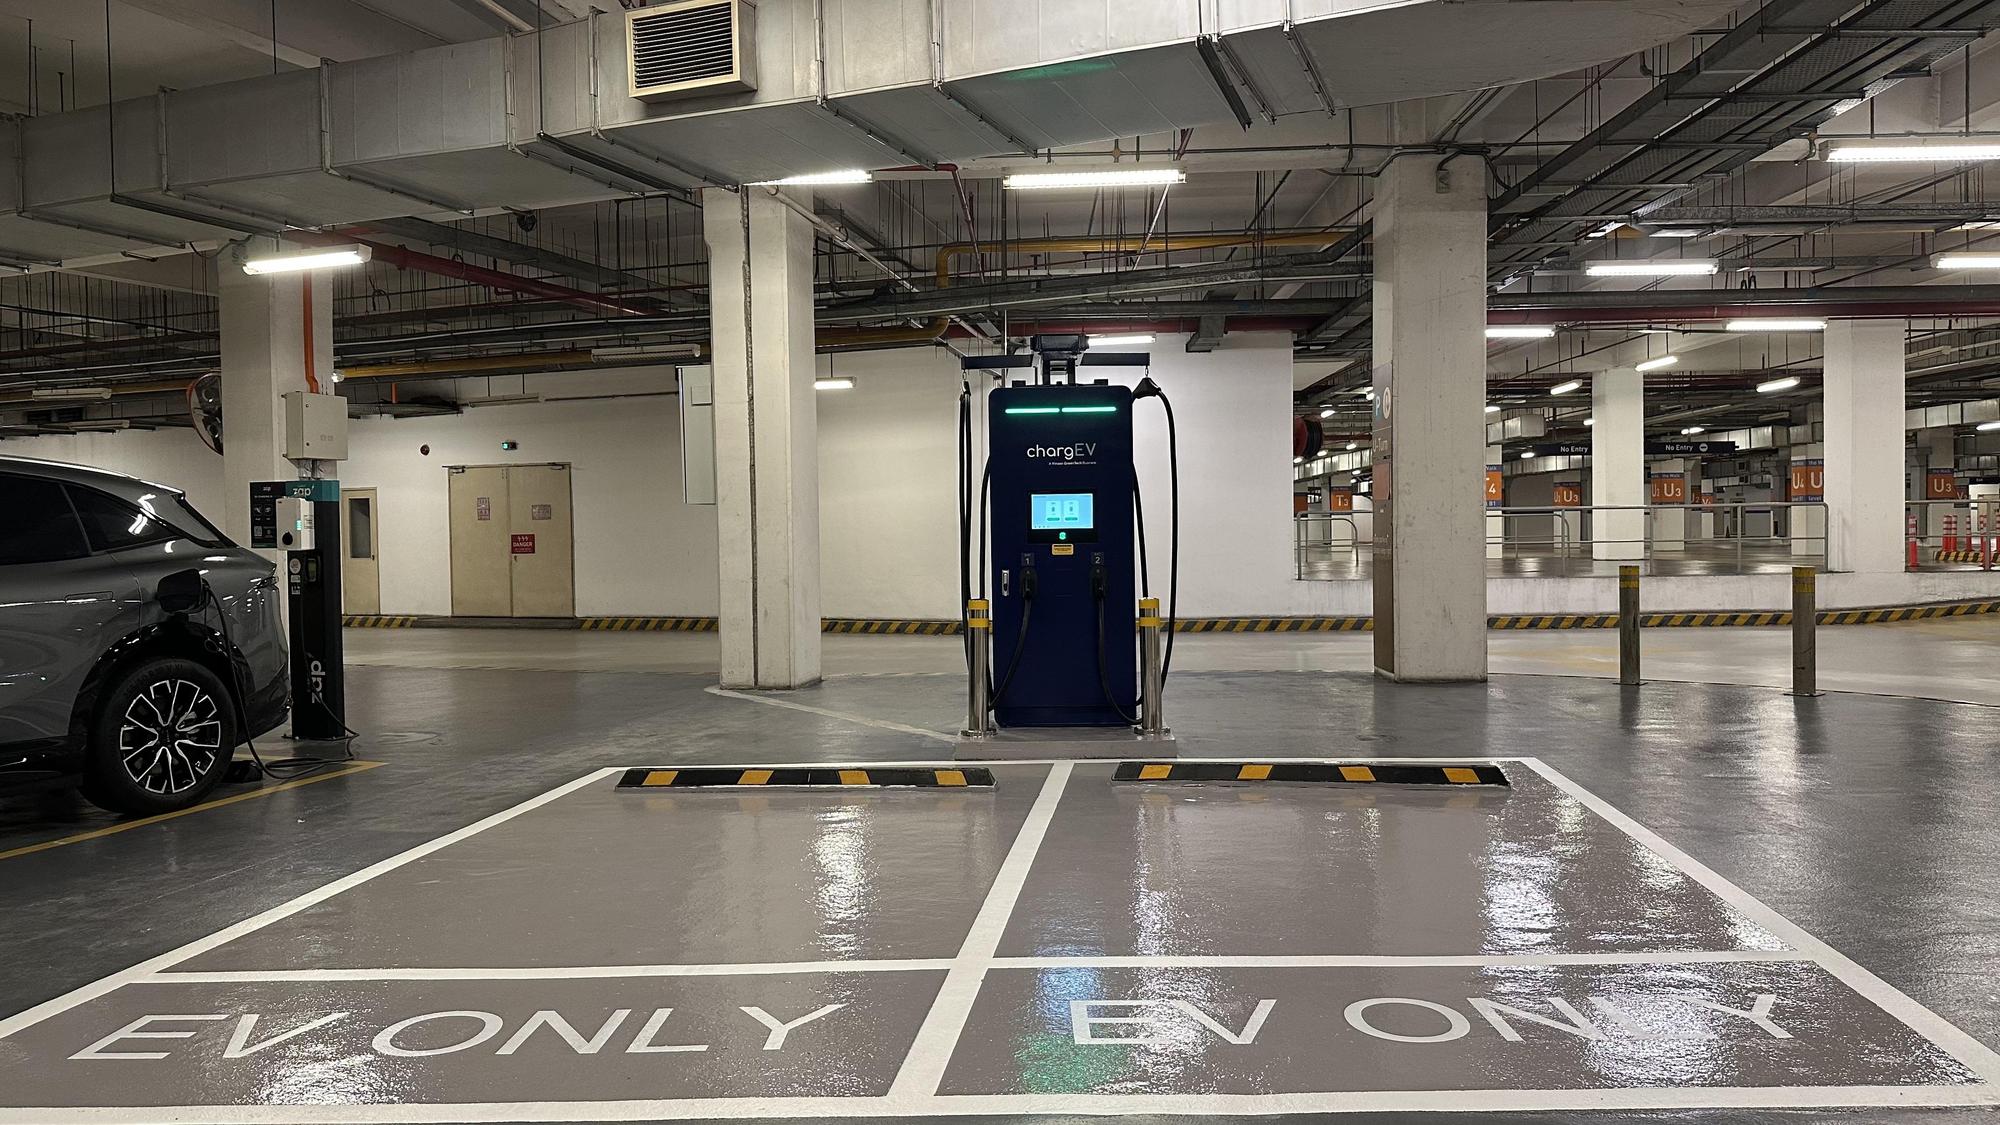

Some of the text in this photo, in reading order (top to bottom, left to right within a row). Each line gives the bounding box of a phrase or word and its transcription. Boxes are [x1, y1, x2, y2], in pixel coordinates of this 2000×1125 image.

[1026, 443, 1096, 460] chargEV
[1810, 471, 1823, 488] U
[1934, 479, 1952, 493] U3
[1563, 490, 1578, 502] U3
[1663, 483, 1682, 497] U3
[1335, 495, 1349, 506] T3
[1070, 994, 1794, 1045] EV ONLY
[67, 1004, 848, 1059] EV ONLY
